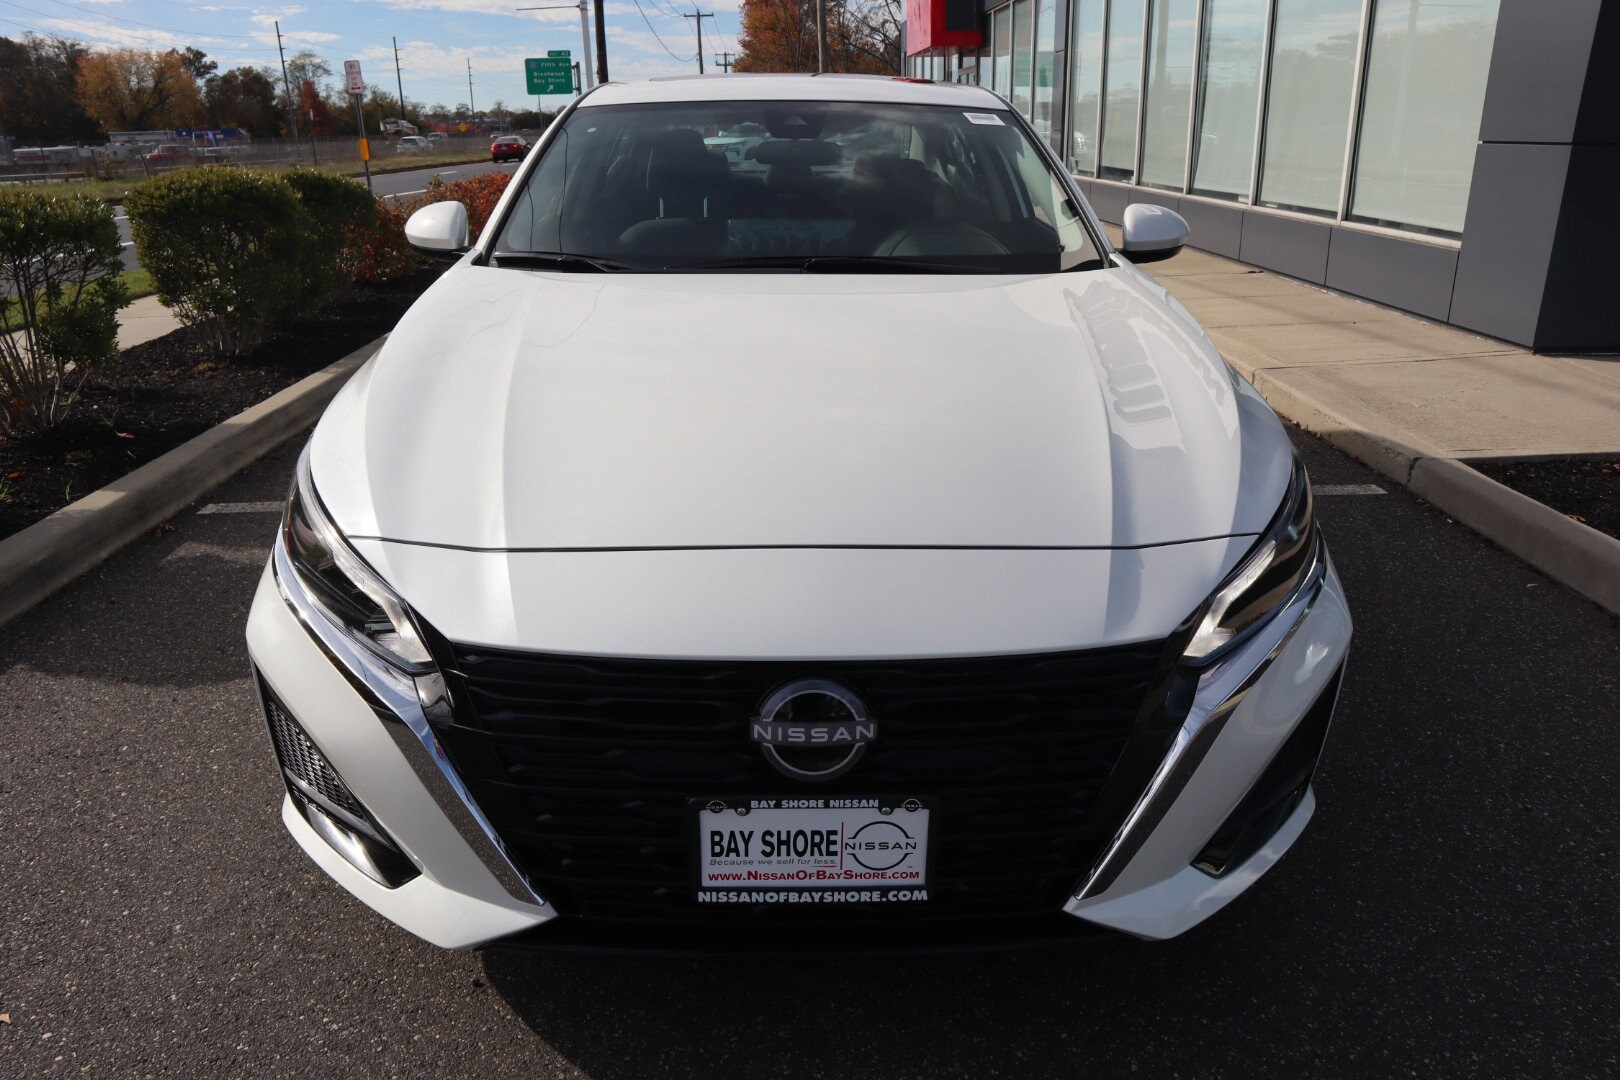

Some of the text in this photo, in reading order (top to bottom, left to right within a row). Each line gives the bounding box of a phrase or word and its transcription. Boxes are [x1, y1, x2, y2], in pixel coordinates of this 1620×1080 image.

[753, 723, 874, 743] NISSAN
[750, 799, 879, 809] BAY SHORE NISSAN
[710, 829, 838, 858] BAY SHORE
[844, 841, 917, 850] NISSAN
[709, 858, 755, 866] Because
[698, 890, 928, 903] NISSANOFBAYSHORE.COM
